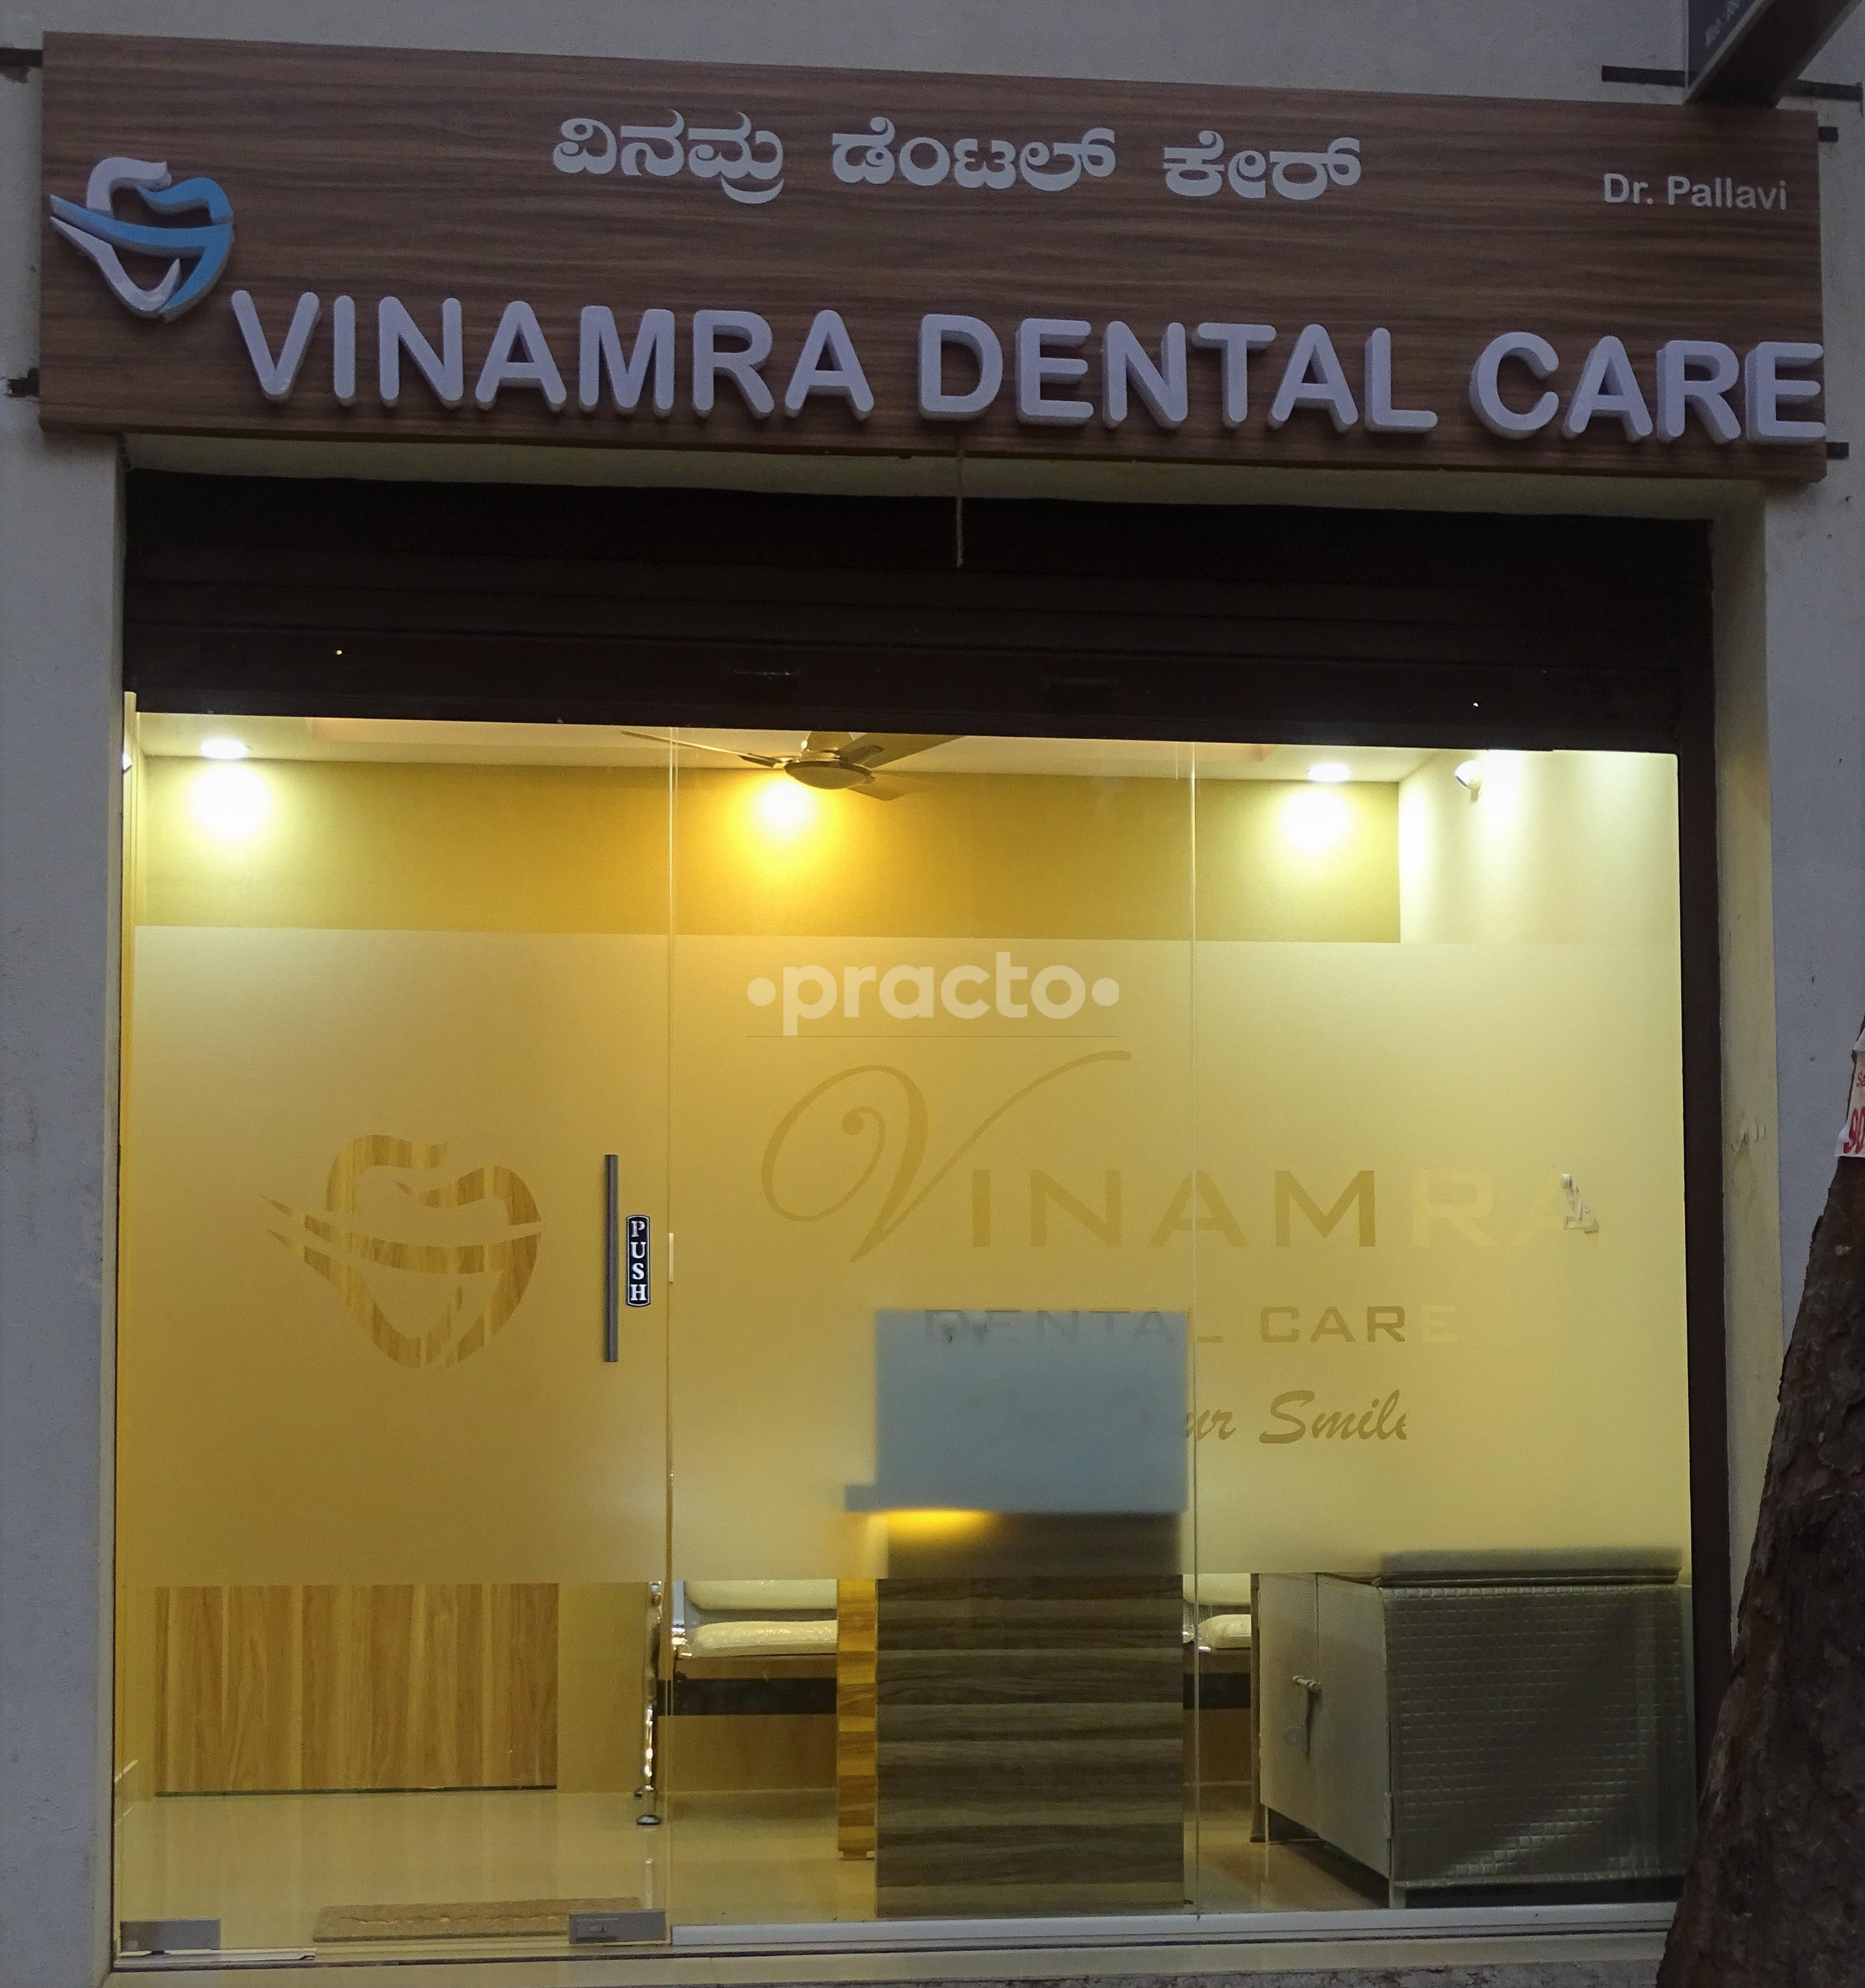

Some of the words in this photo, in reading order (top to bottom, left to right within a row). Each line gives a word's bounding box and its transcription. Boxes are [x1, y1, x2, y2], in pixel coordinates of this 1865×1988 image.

[553, 109, 784, 205] ವಿನಮ್ರ
[832, 116, 1117, 192] ಡೆಂಟಲ್
[1162, 130, 1362, 201] ಕೇರ್
[1604, 172, 1654, 205] Dr.
[1667, 175, 1787, 211] Pallavi
[230, 289, 875, 421] VINAMRA
[918, 313, 1439, 434] DENTAL
[1469, 331, 1827, 443] CARE
[760, 1049, 1601, 1264] VINAMRA
[629, 1220, 648, 1301] PUSH
[1260, 1305, 1459, 1343] CARE
